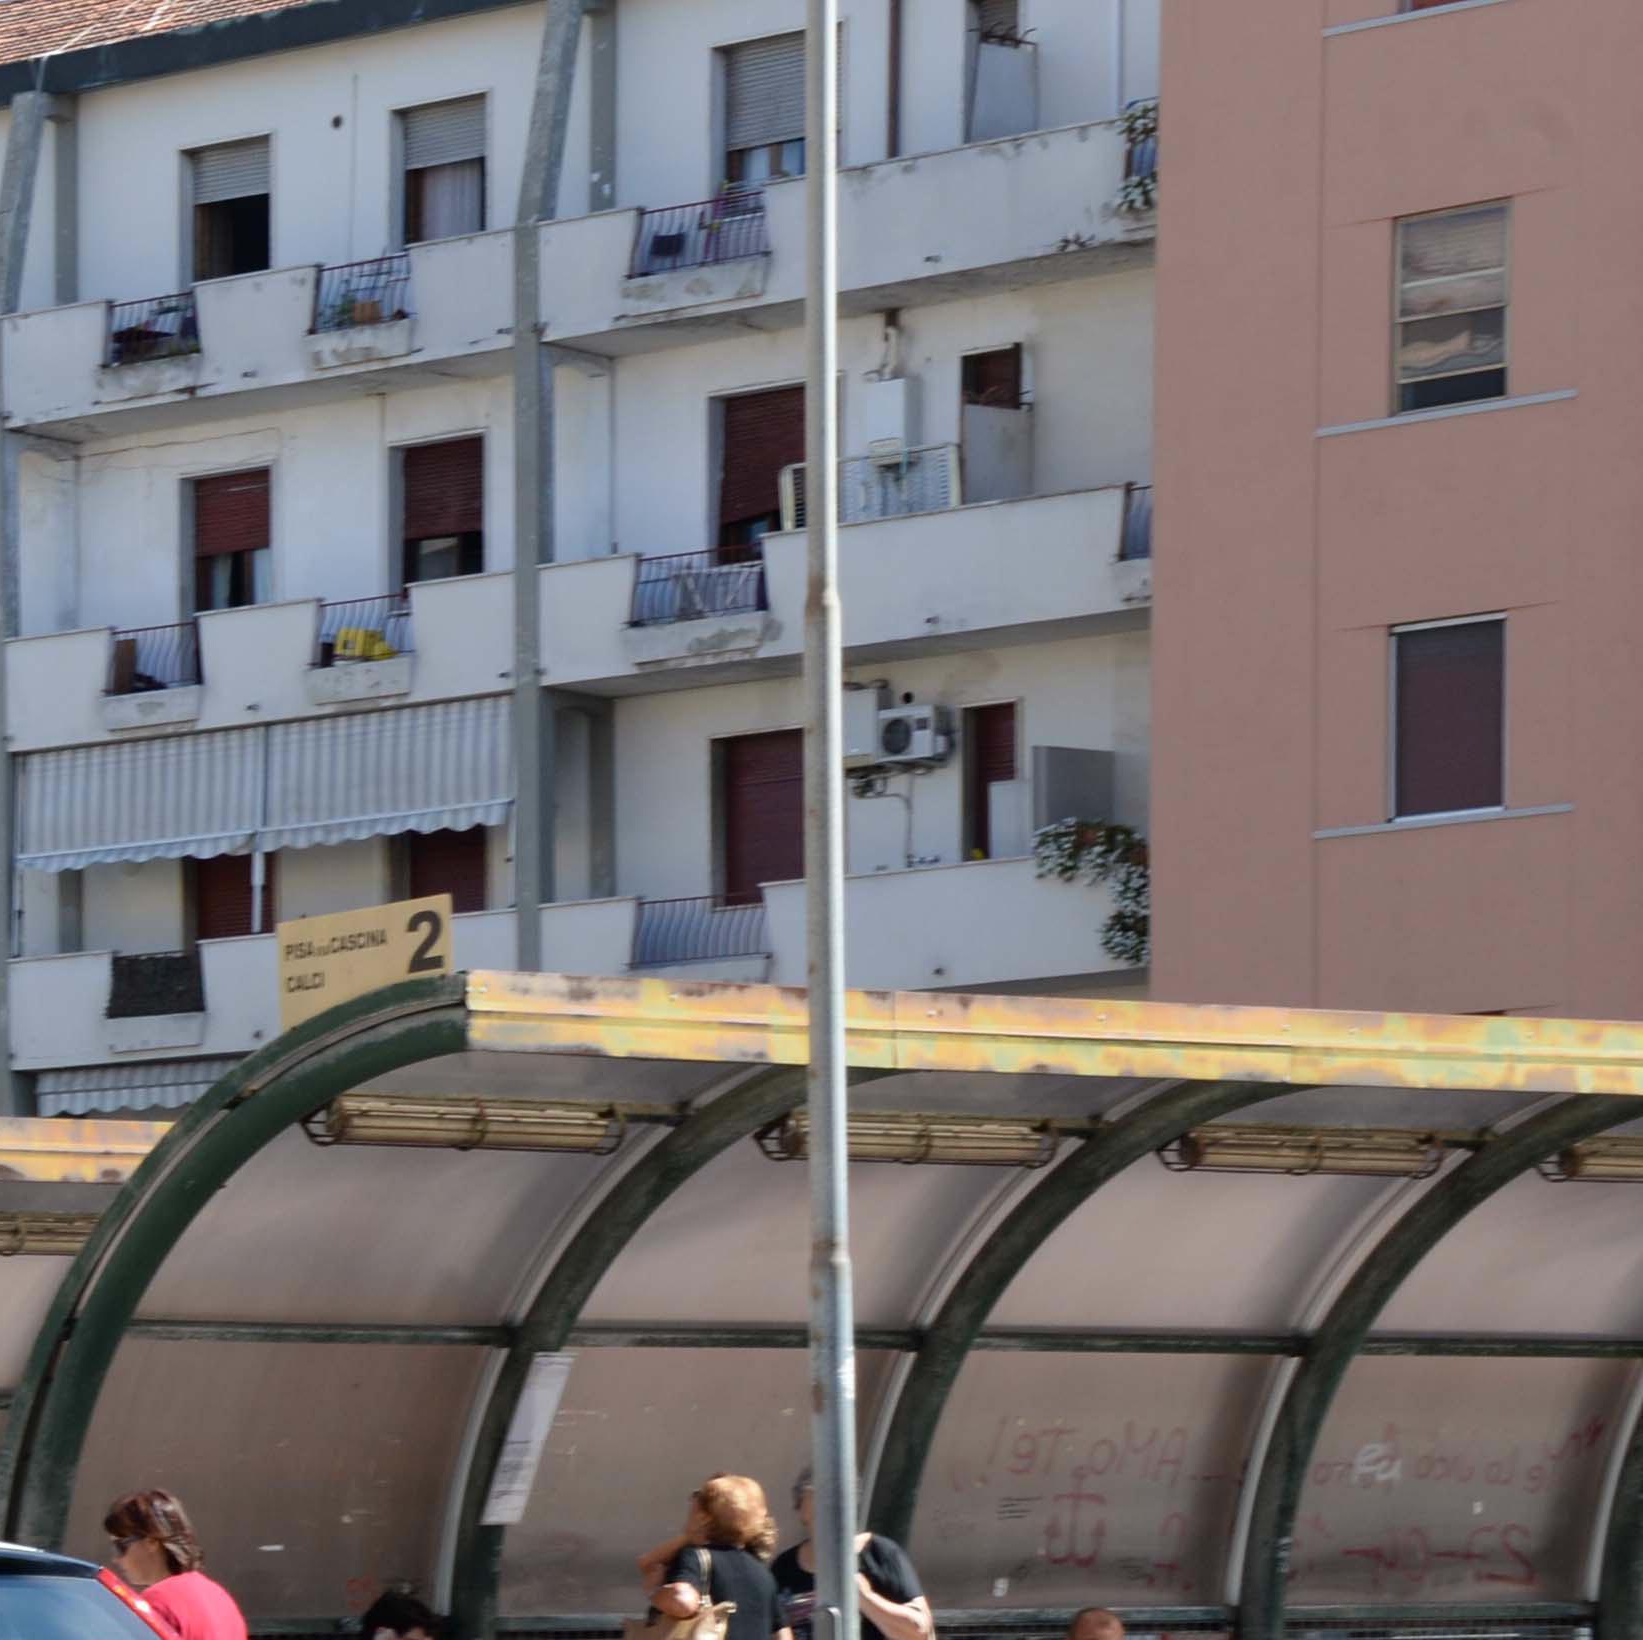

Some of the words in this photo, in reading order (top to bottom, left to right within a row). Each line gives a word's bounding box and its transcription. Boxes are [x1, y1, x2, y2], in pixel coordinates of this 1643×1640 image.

[285, 940, 315, 961] PISA
[330, 928, 388, 953] CASCINA
[406, 909, 445, 975] 2
[286, 972, 326, 993] CALCI
